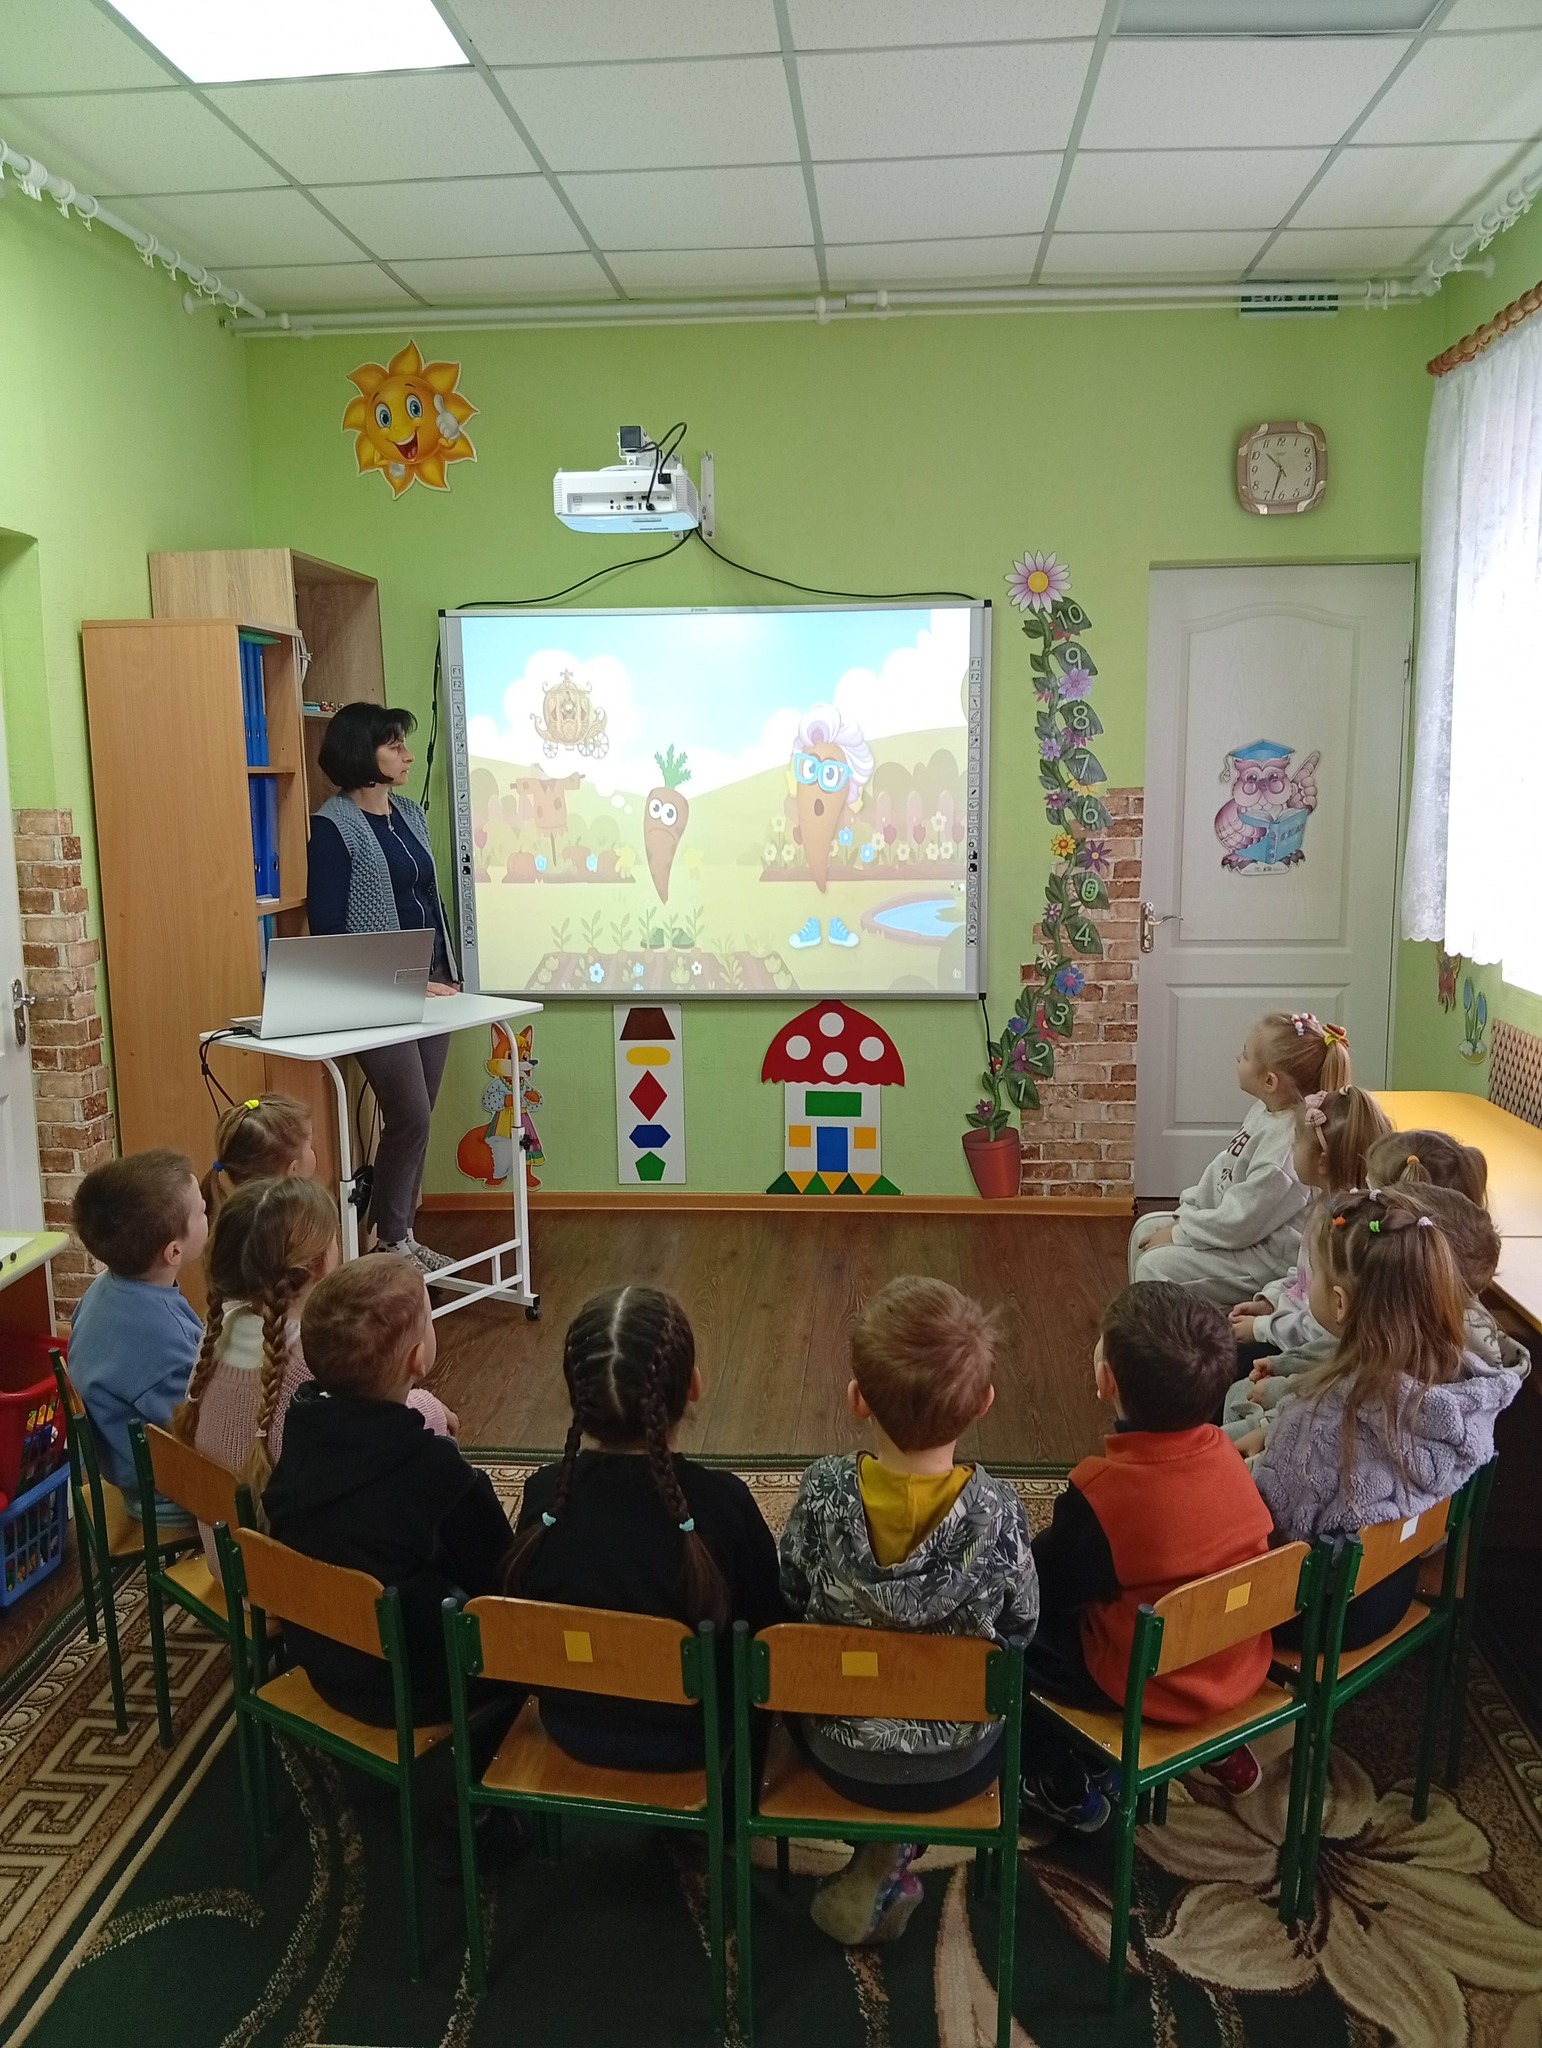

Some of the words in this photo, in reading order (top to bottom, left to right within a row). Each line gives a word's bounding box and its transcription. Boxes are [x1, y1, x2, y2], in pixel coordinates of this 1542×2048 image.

[1263, 439, 1270, 448] 11
[1276, 437, 1286, 446] 12
[1251, 450, 1261, 460] 10
[1304, 447, 1311, 457] 2
[1251, 465, 1259, 475] 9
[1305, 462, 1312, 472] 3
[1252, 480, 1259, 491] 8
[1304, 477, 1311, 487] 4
[1263, 490, 1270, 500] 7
[1278, 492, 1285, 501] 6
[1292, 488, 1300, 498] 5
[1056, 604, 1084, 630] 10
[971, 659, 980, 667] F1
[1065, 647, 1082, 671] 9
[452, 667, 461, 675] F1
[970, 673, 980, 681] F2
[453, 680, 462, 688] F2
[1072, 705, 1090, 730] 8
[1075, 753, 1090, 779] 7
[1082, 800, 1099, 824] 6
[1074, 922, 1092, 947] 4
[1049, 1002, 1069, 1026] 3
[1028, 1042, 1050, 1067] 2
[1017, 1078, 1027, 1102] 1
